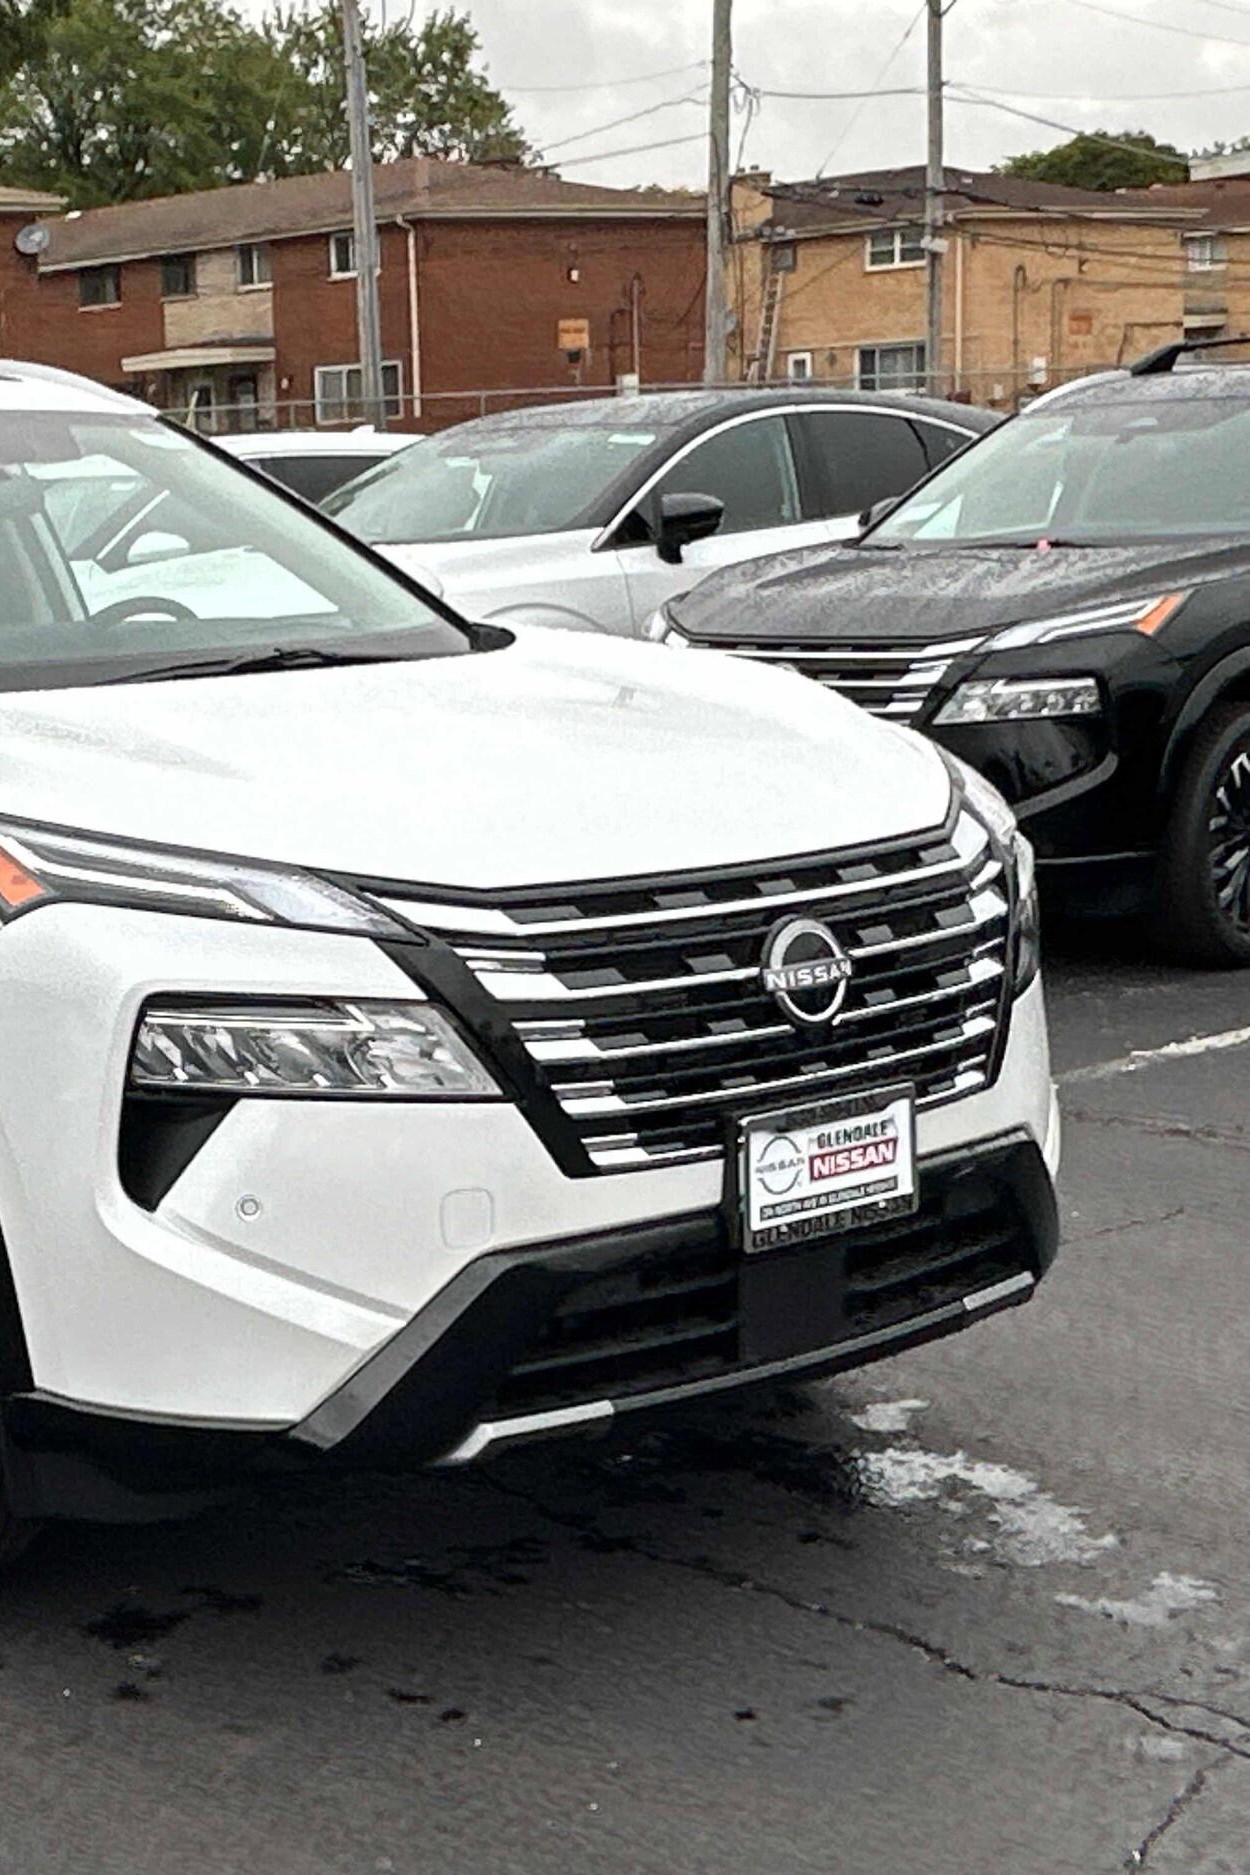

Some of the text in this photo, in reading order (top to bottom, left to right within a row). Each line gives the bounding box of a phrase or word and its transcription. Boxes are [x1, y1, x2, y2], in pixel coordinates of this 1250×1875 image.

[766, 960, 852, 991] NISSAN
[817, 1119, 889, 1149] GLENDALE
[755, 1155, 805, 1174] NISSAN
[812, 1141, 895, 1179] NISSAN
